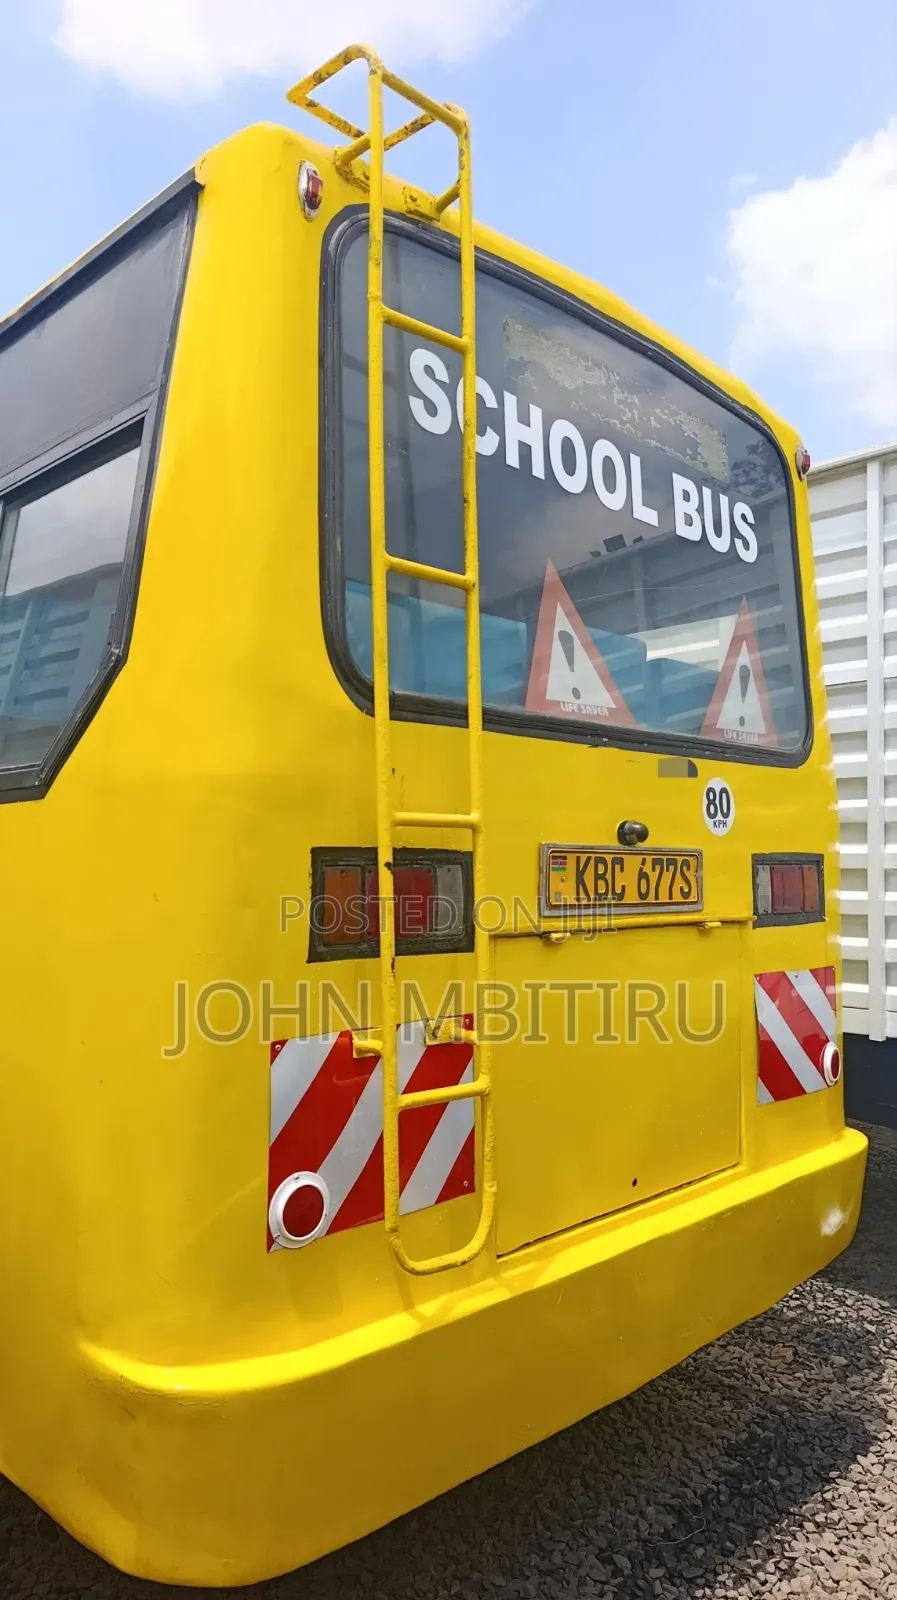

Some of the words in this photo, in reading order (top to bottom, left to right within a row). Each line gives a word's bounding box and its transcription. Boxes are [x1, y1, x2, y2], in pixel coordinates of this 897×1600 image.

[408, 347, 659, 528] SCHOOL
[671, 472, 759, 564] BUS
[580, 703, 609, 716] SAVER
[705, 786, 731, 820] 80
[712, 819, 728, 828] KPH
[575, 855, 626, 902] KBC
[637, 857, 693, 901] 677S
